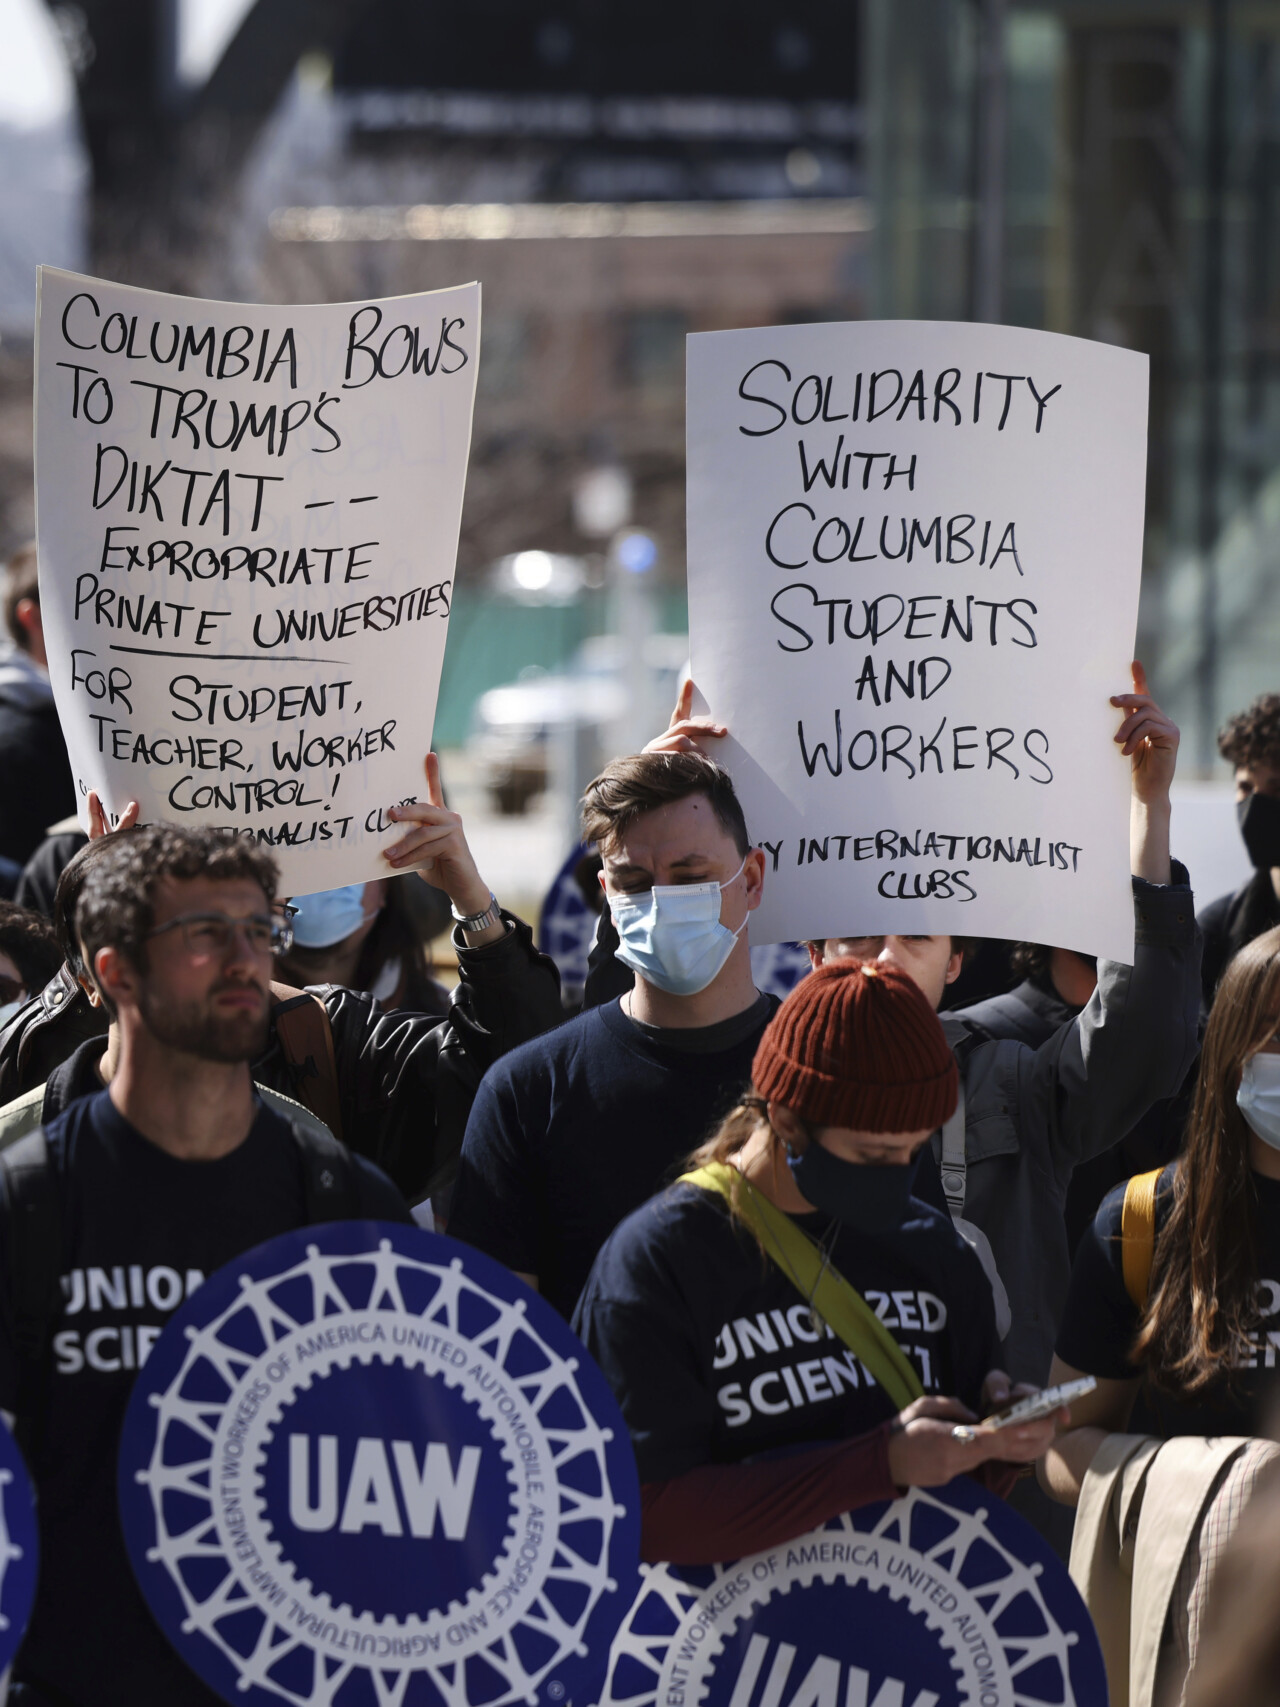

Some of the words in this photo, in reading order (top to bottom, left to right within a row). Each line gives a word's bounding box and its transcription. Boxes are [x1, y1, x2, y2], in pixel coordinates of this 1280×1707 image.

[61, 293, 298, 389] COLUMBIA
[342, 306, 468, 388] BOWS
[56, 362, 113, 424] TO
[130, 380, 342, 457] TRUMP'S
[738, 359, 1062, 436] SOLIDARITY
[93, 443, 284, 536] DIKTAT
[799, 435, 917, 492] WITH
[100, 527, 380, 588] EXPROPRIATE
[765, 502, 1024, 576] COLUMBIA
[74, 573, 232, 645] PRIVATE
[253, 580, 451, 648] UNIVERSITIES
[771, 583, 1038, 652] STUDENTS
[71, 649, 133, 714] FOR
[169, 675, 362, 725] STUDENT,
[854, 655, 952, 706] AND
[88, 713, 254, 773] TEACHER,
[272, 719, 397, 773] WORKER
[797, 709, 1053, 784] WORKERS
[168, 773, 341, 814] CONTROL!
[797, 829, 1083, 873] INTERNATIONALIST
[877, 869, 977, 901] CLUBS
[295, 1322, 387, 1362] AMERICA
[393, 1325, 468, 1368] UNITED
[712, 1289, 948, 1369] UNIOZED
[265, 1352, 292, 1383] OF
[716, 1344, 940, 1426] SCIENT.
[222, 1378, 272, 1480] WORKERS
[289, 1433, 481, 1540] UAW
[220, 1484, 288, 1606] IMPLEMENT
[486, 1502, 545, 1618] AEROSPACE
[287, 1599, 440, 1658] AGRICULTURAL
[445, 1609, 489, 1647] AND
[677, 1572, 751, 1662] WORKERS
[752, 1554, 778, 1582] OF
[786, 1542, 879, 1570] AMERICA
[886, 1555, 958, 1614] UNITED
[952, 1613, 1000, 1707] AUTOMO
